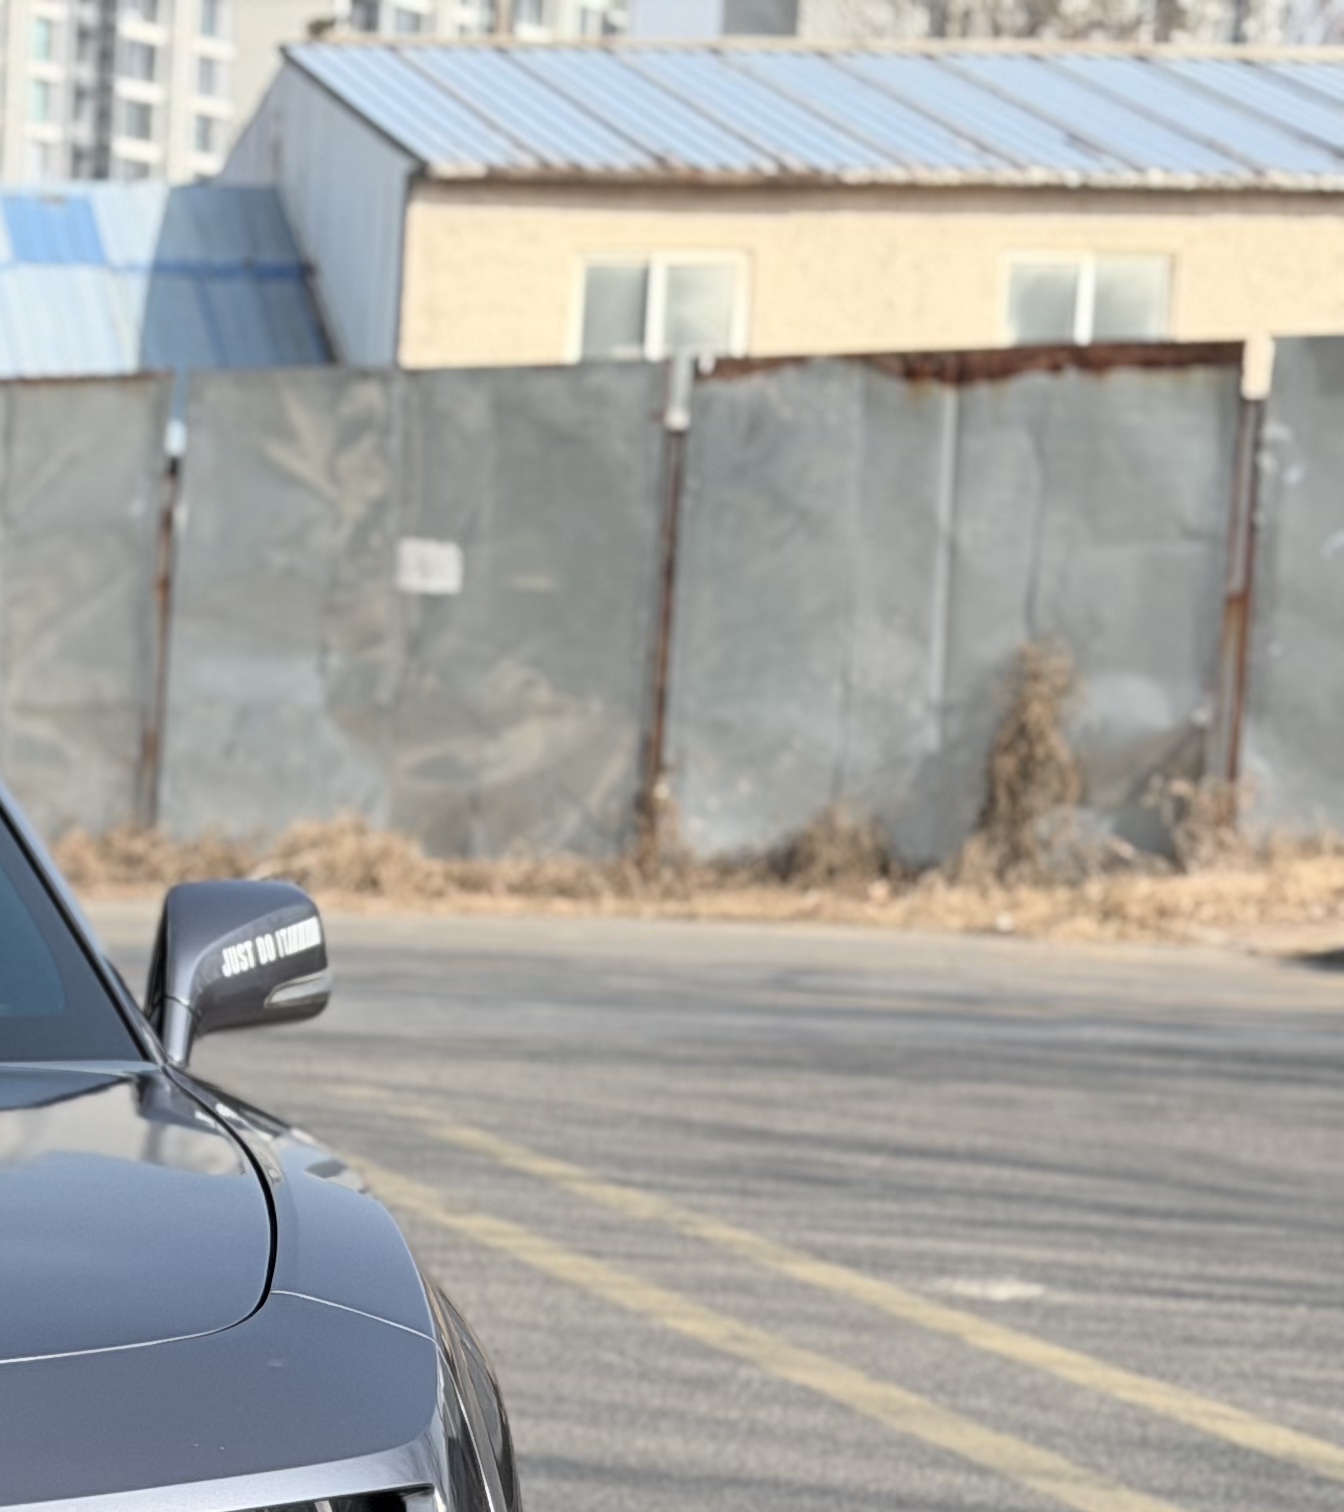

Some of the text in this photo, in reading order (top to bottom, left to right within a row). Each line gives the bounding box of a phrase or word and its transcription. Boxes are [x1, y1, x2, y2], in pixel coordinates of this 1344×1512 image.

[221, 928, 290, 978] JUST DO IT
